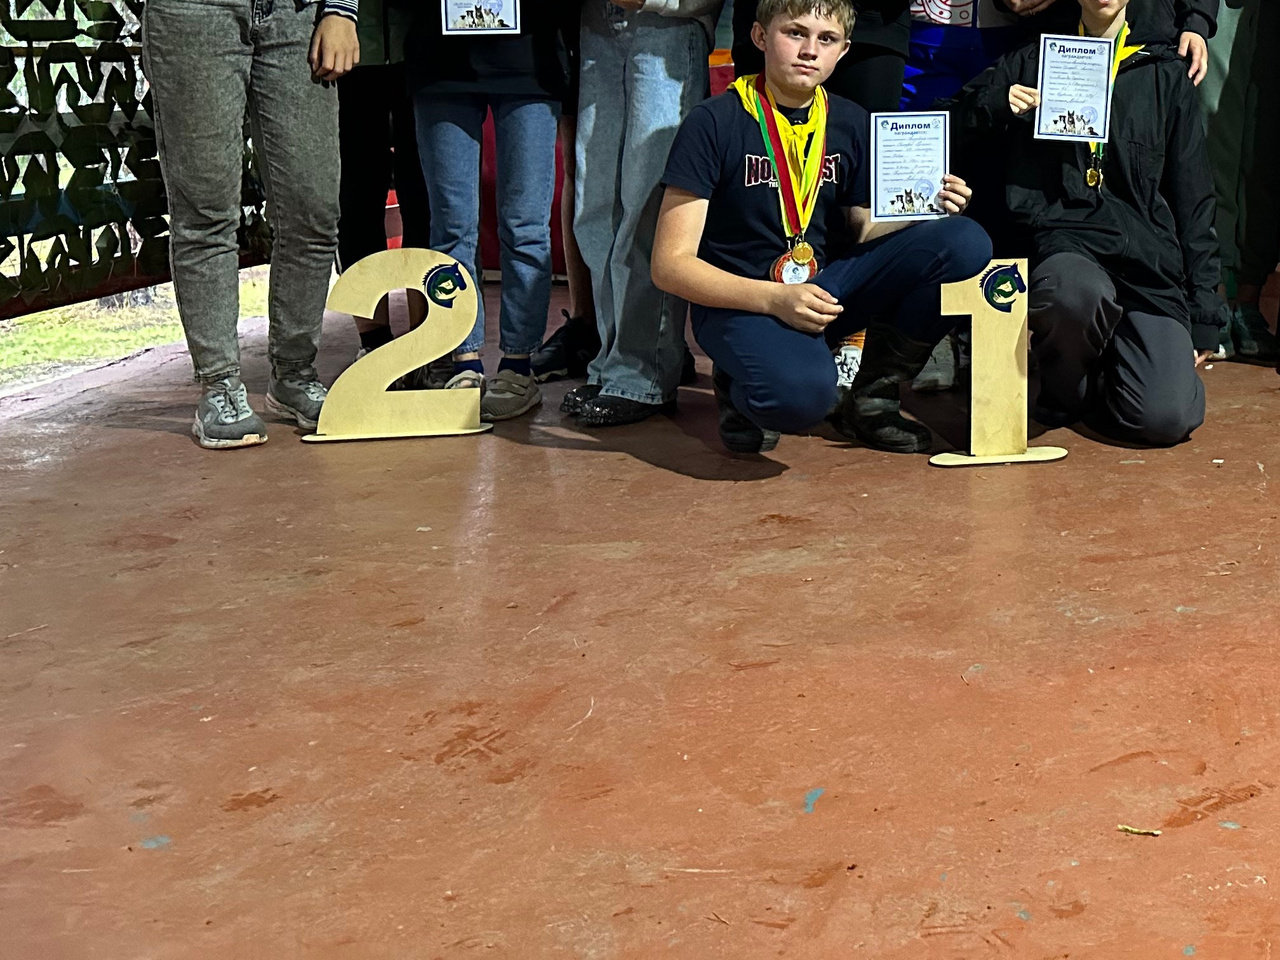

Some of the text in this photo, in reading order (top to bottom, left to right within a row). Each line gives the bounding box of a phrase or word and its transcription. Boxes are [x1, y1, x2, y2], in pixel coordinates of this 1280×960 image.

[1057, 45, 1096, 55] Диплом
[890, 122, 931, 132] Диплом
[316, 247, 481, 435] 2
[940, 257, 1029, 456] 1
